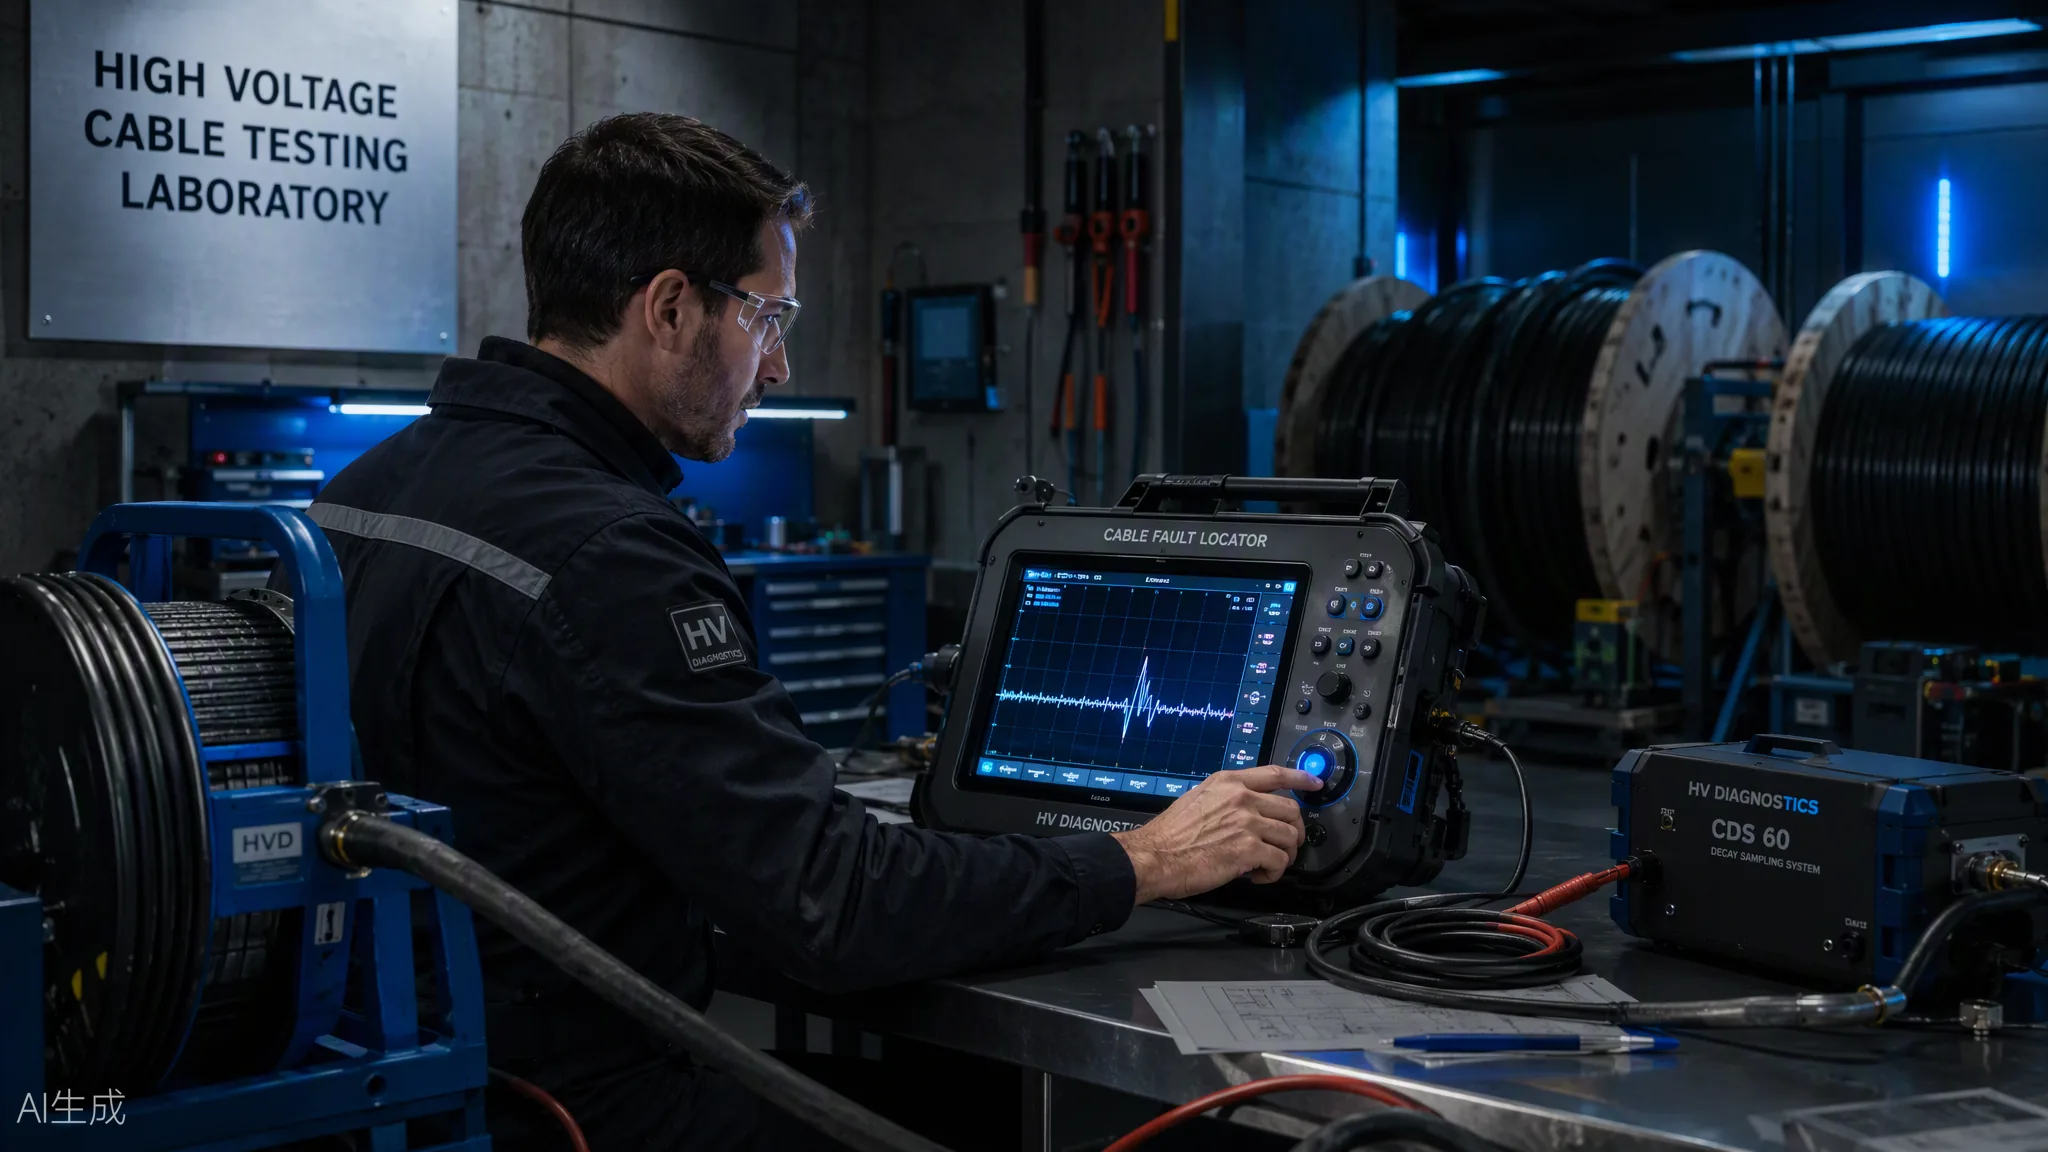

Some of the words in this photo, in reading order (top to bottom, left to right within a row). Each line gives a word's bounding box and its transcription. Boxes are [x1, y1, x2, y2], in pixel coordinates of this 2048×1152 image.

[94, 50, 205, 98] HIGH
[224, 65, 398, 119] VOLTAGE
[84, 109, 225, 157] CABLE
[243, 124, 408, 172] TESTING
[121, 171, 389, 225] LABORATORY
[1103, 528, 1149, 543] CABLE
[1151, 530, 1197, 544] FAULT
[1199, 532, 1268, 548] LOCATOR
[682, 615, 727, 650] HV
[692, 649, 743, 667] DIAGNOSTICS
[1688, 781, 1711, 798] HV
[1714, 785, 1819, 815] DIAGNOSTICS
[1036, 811, 1058, 826] HV
[1711, 818, 1756, 844] CDS
[1762, 826, 1790, 850] 60
[242, 831, 294, 853] HVD
[1711, 846, 1738, 860] DECAY
[1740, 852, 1784, 868] SAMPLING
[1785, 860, 1821, 875] SYSTEM
